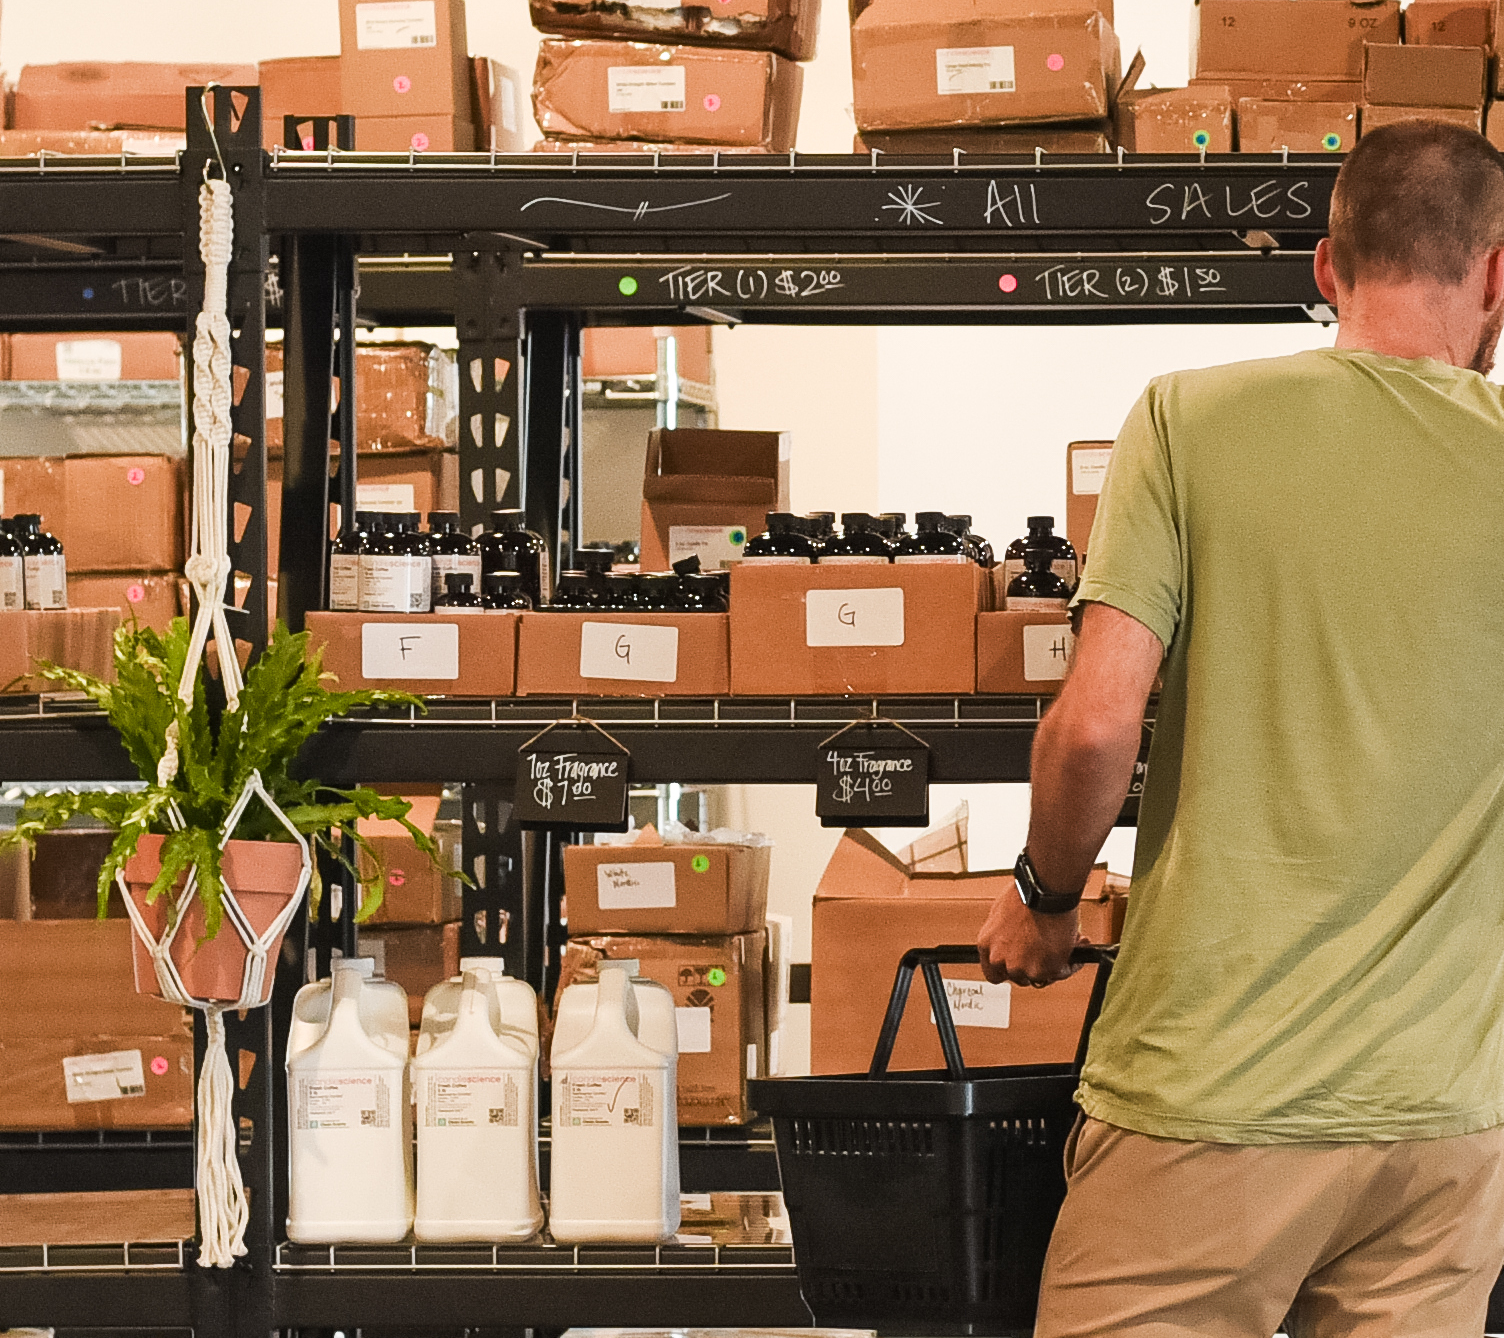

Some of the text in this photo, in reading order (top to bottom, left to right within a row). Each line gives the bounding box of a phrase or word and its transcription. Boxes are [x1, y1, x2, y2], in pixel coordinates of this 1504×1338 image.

[1221, 17, 1236, 26] 12
[984, 180, 1312, 226] All SALES
[658, 269, 732, 300] TIER
[737, 270, 767, 300] (1)
[1036, 265, 1108, 299] TIER
[1115, 270, 1147, 296] (2)
[838, 603, 856, 627] G
[398, 635, 420, 662] F
[614, 634, 632, 664] G
[1049, 638, 1067, 661] H
[554, 754, 619, 789] Fragrance
[855, 752, 913, 779] Fragrance
